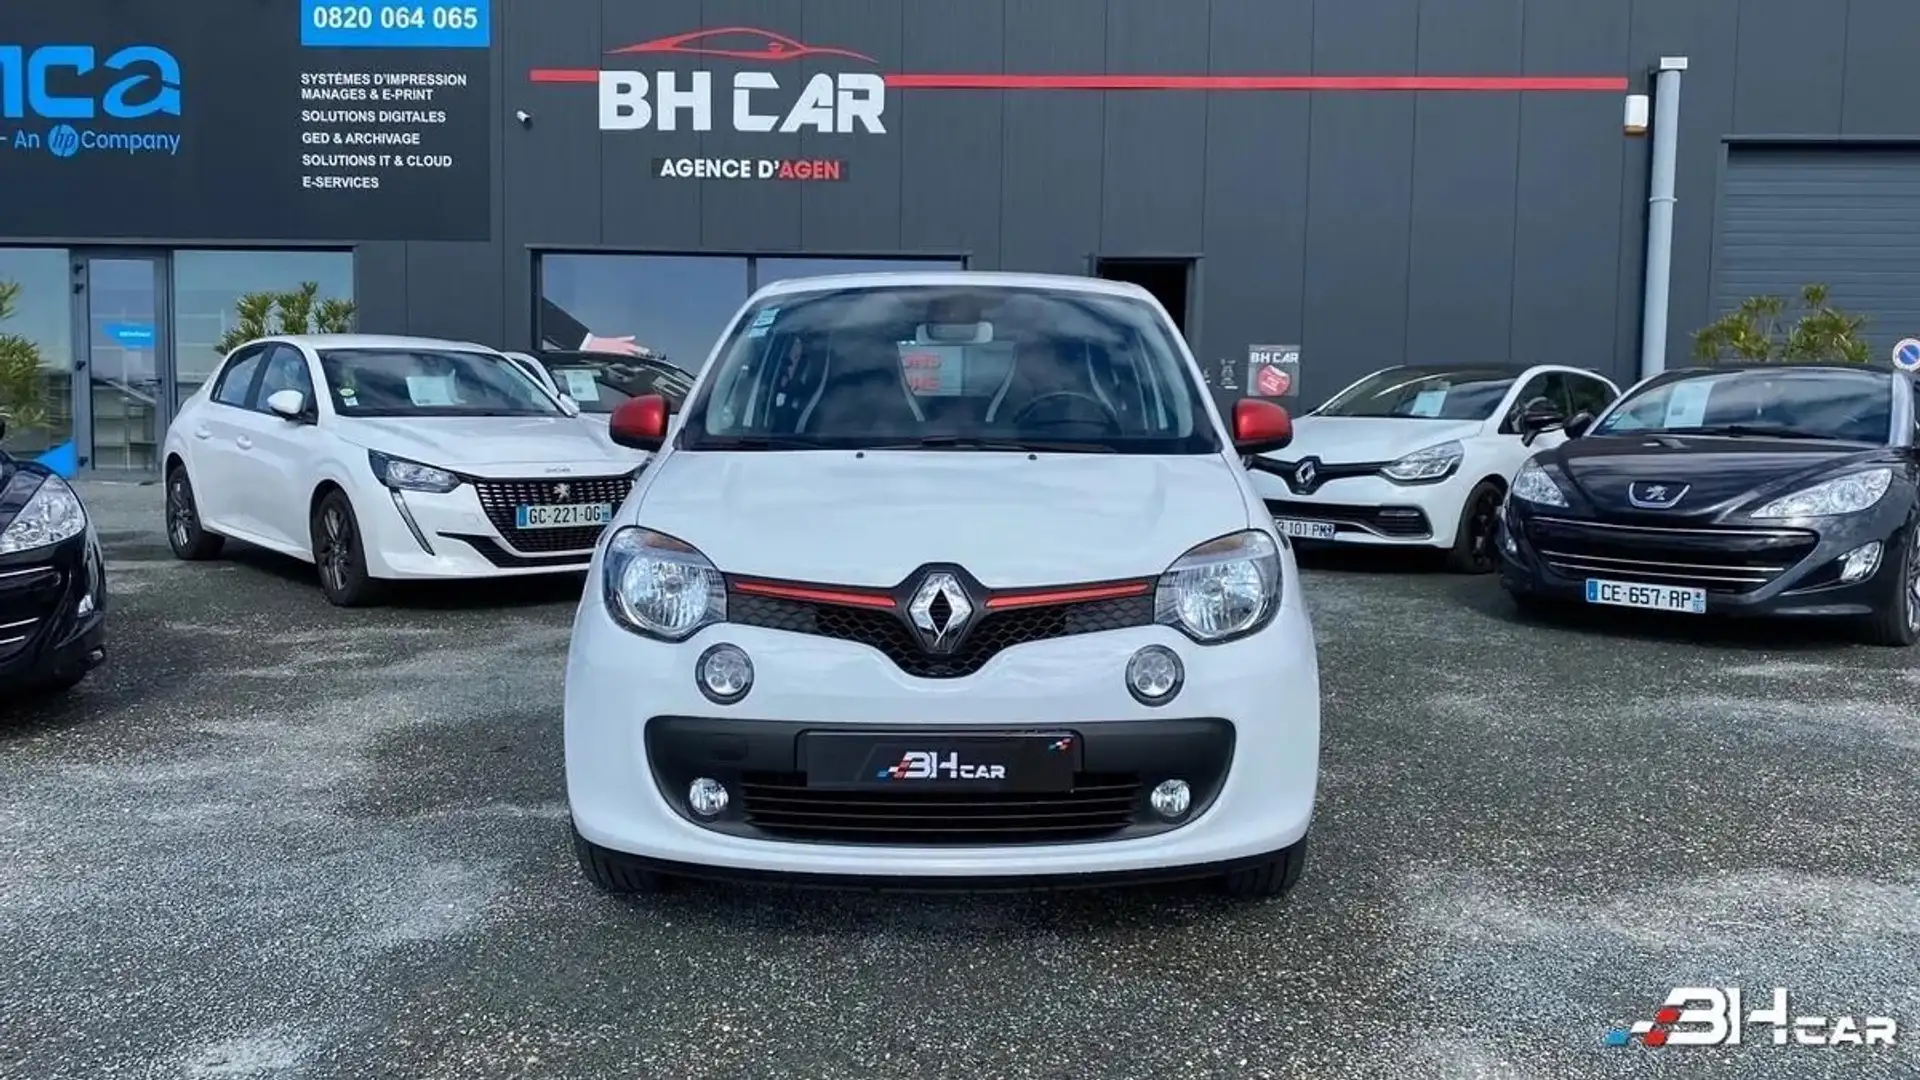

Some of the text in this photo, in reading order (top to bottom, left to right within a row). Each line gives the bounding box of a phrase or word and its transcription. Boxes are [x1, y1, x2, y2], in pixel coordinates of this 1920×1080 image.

[313, 6, 478, 29] 0820 064 065
[374, 73, 467, 86] D'IMPRESSION
[301, 88, 434, 101] MANAGES & E-PRINT
[599, 70, 887, 133] BH CAR
[302, 110, 447, 123] SOLUTIONS DIGITALES
[14, 129, 40, 149] An
[81, 130, 181, 156] Company
[302, 132, 421, 145] GED & ARCHIVAGE
[302, 155, 453, 168] SOLUTIONS IT & CLOUD
[660, 158, 840, 179] AGENCE D'AGEN
[302, 176, 379, 189] E-SERVICES
[1250, 352, 1299, 364] BH CAR
[1601, 583, 1691, 609] CE-657-RP
